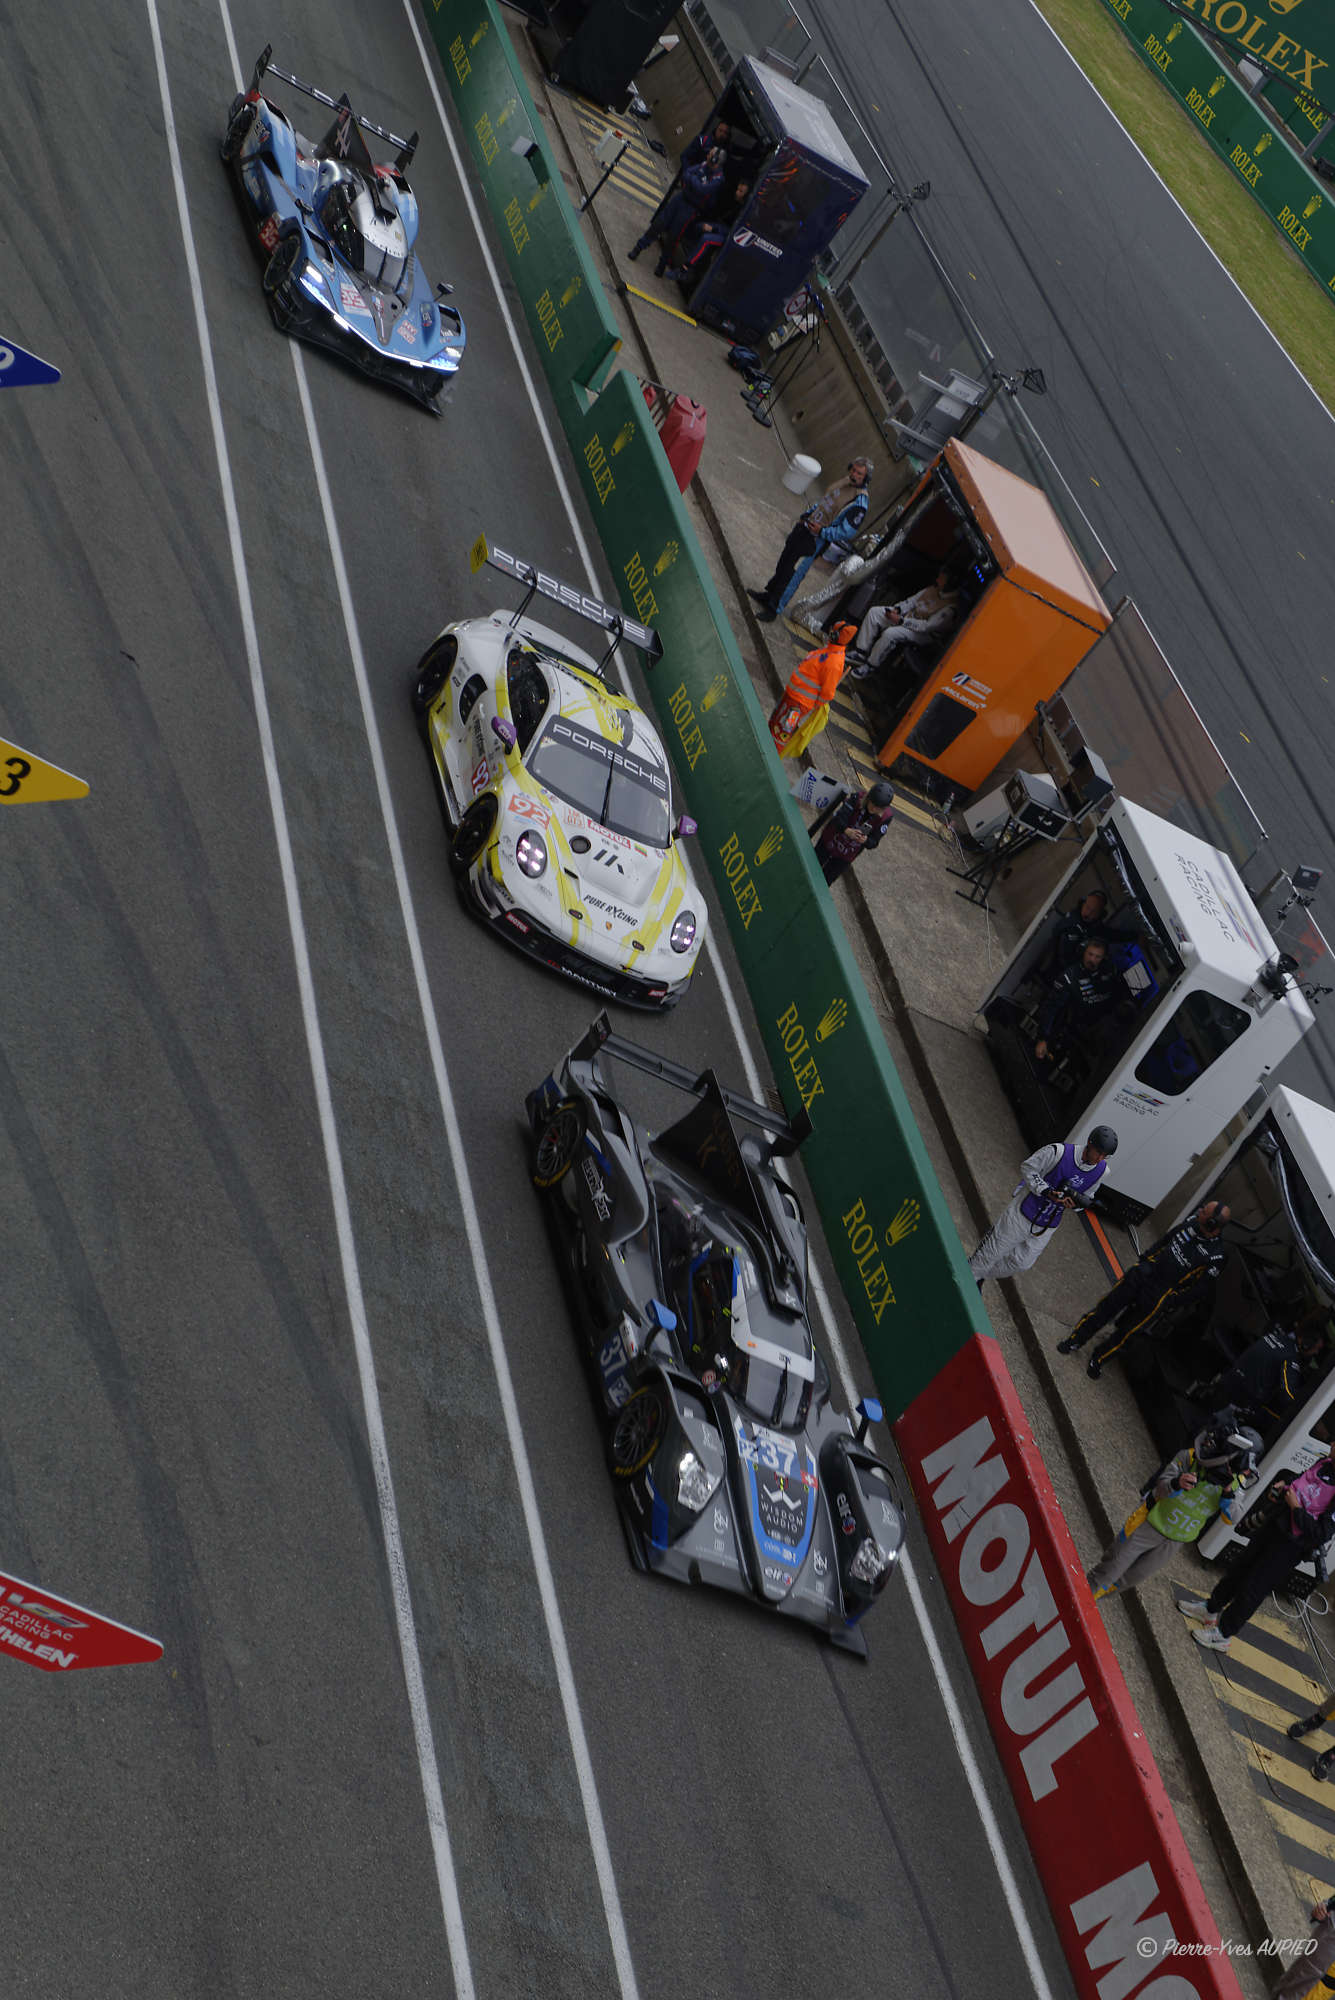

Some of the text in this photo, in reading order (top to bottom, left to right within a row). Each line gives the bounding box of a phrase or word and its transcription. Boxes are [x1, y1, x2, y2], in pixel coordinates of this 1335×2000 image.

[450, 34, 472, 88] ROLEX
[1144, 33, 1173, 73] ROLEX
[1185, 87, 1216, 129] ROLEX
[475, 111, 499, 167] ROLEX
[1229, 144, 1263, 188] ROLEX
[504, 196, 530, 255] ROLEX
[1277, 205, 1312, 252] ROLEX
[535, 288, 565, 353] ROLEX
[584, 433, 616, 506] ROLEX
[623, 551, 660, 627] ROLEX
[668, 682, 708, 773] ROLEX
[552, 723, 667, 792] PORSCHE
[512, 795, 551, 828] 92
[583, 894, 607, 911] PURE
[719, 832, 763, 931] ROLEX
[1187, 860, 1236, 943] CADILLAC
[776, 1001, 825, 1110] ROLEX
[1113, 1098, 1146, 1116] RACING
[1117, 1093, 1160, 1117] CADILLAC
[842, 1197, 896, 1325] ROLEX
[600, 1333, 628, 1377] 37
[739, 1439, 796, 1475] P2 37
[760, 1499, 804, 1527] WISDOM
[765, 1511, 798, 1534] AUDIO
[920, 1415, 1099, 1802] MOTUL
